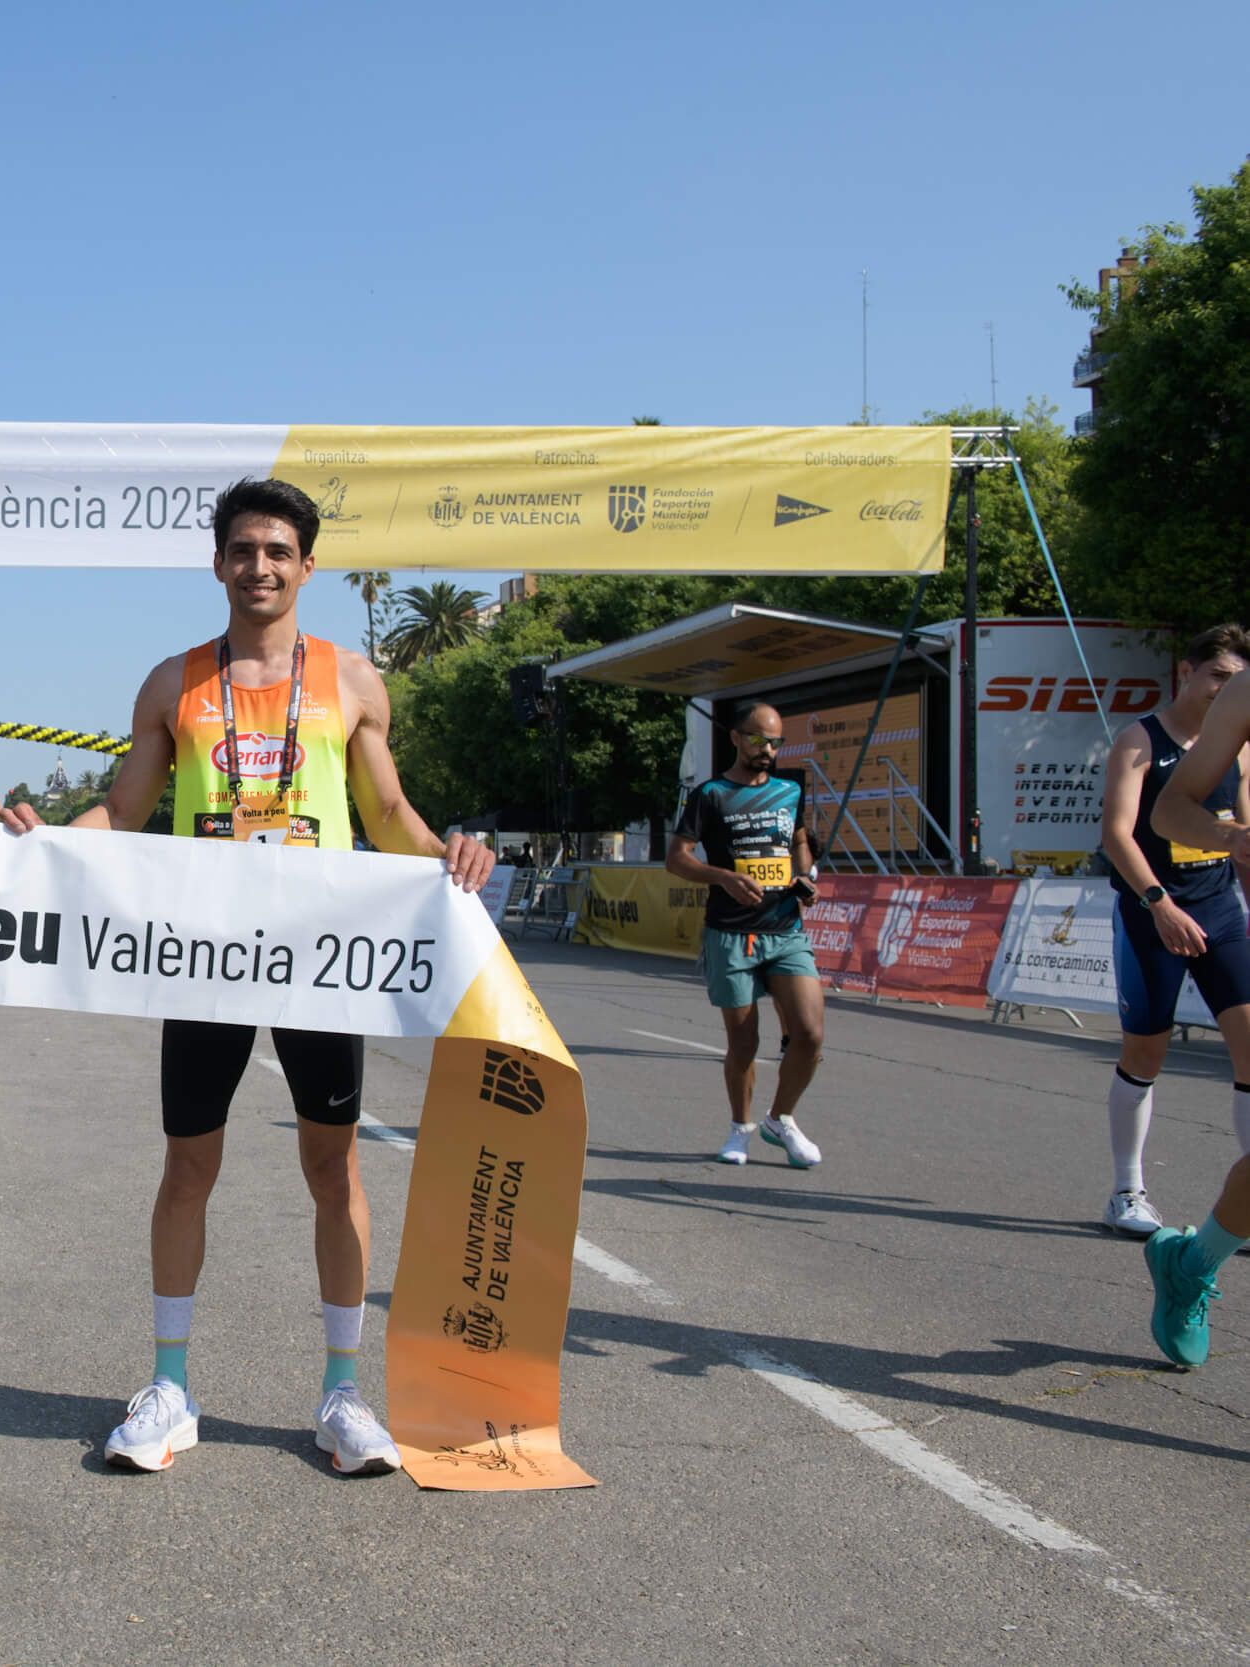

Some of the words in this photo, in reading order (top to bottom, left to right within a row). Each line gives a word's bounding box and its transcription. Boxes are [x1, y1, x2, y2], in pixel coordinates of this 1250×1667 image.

[304, 449, 369, 467] Organitza:
[535, 450, 599, 465] Patrocina:
[475, 493, 582, 507] AJUNTAMENT
[653, 488, 714, 498] Fundación
[121, 486, 216, 530] 2025
[652, 499, 711, 510] Deportiva
[473, 511, 494, 525] DE
[500, 508, 581, 525] VALÈNCIA
[651, 509, 709, 521] Municipal
[978, 676, 1161, 713] SIED
[1014, 764, 1101, 775] SERVIC
[1015, 780, 1095, 791] INTEGRAL
[1015, 796, 1103, 807] EVENT
[1015, 813, 1102, 823] DEPORTIV
[747, 864, 784, 880] 5955
[803, 902, 867, 923] UNTAMENT
[82, 915, 294, 985] València
[313, 934, 436, 993] 2025
[462, 1145, 498, 1291] AJUNTAMENT
[490, 1161, 525, 1263] VALÈNCIA
[486, 1268, 509, 1302] DE
